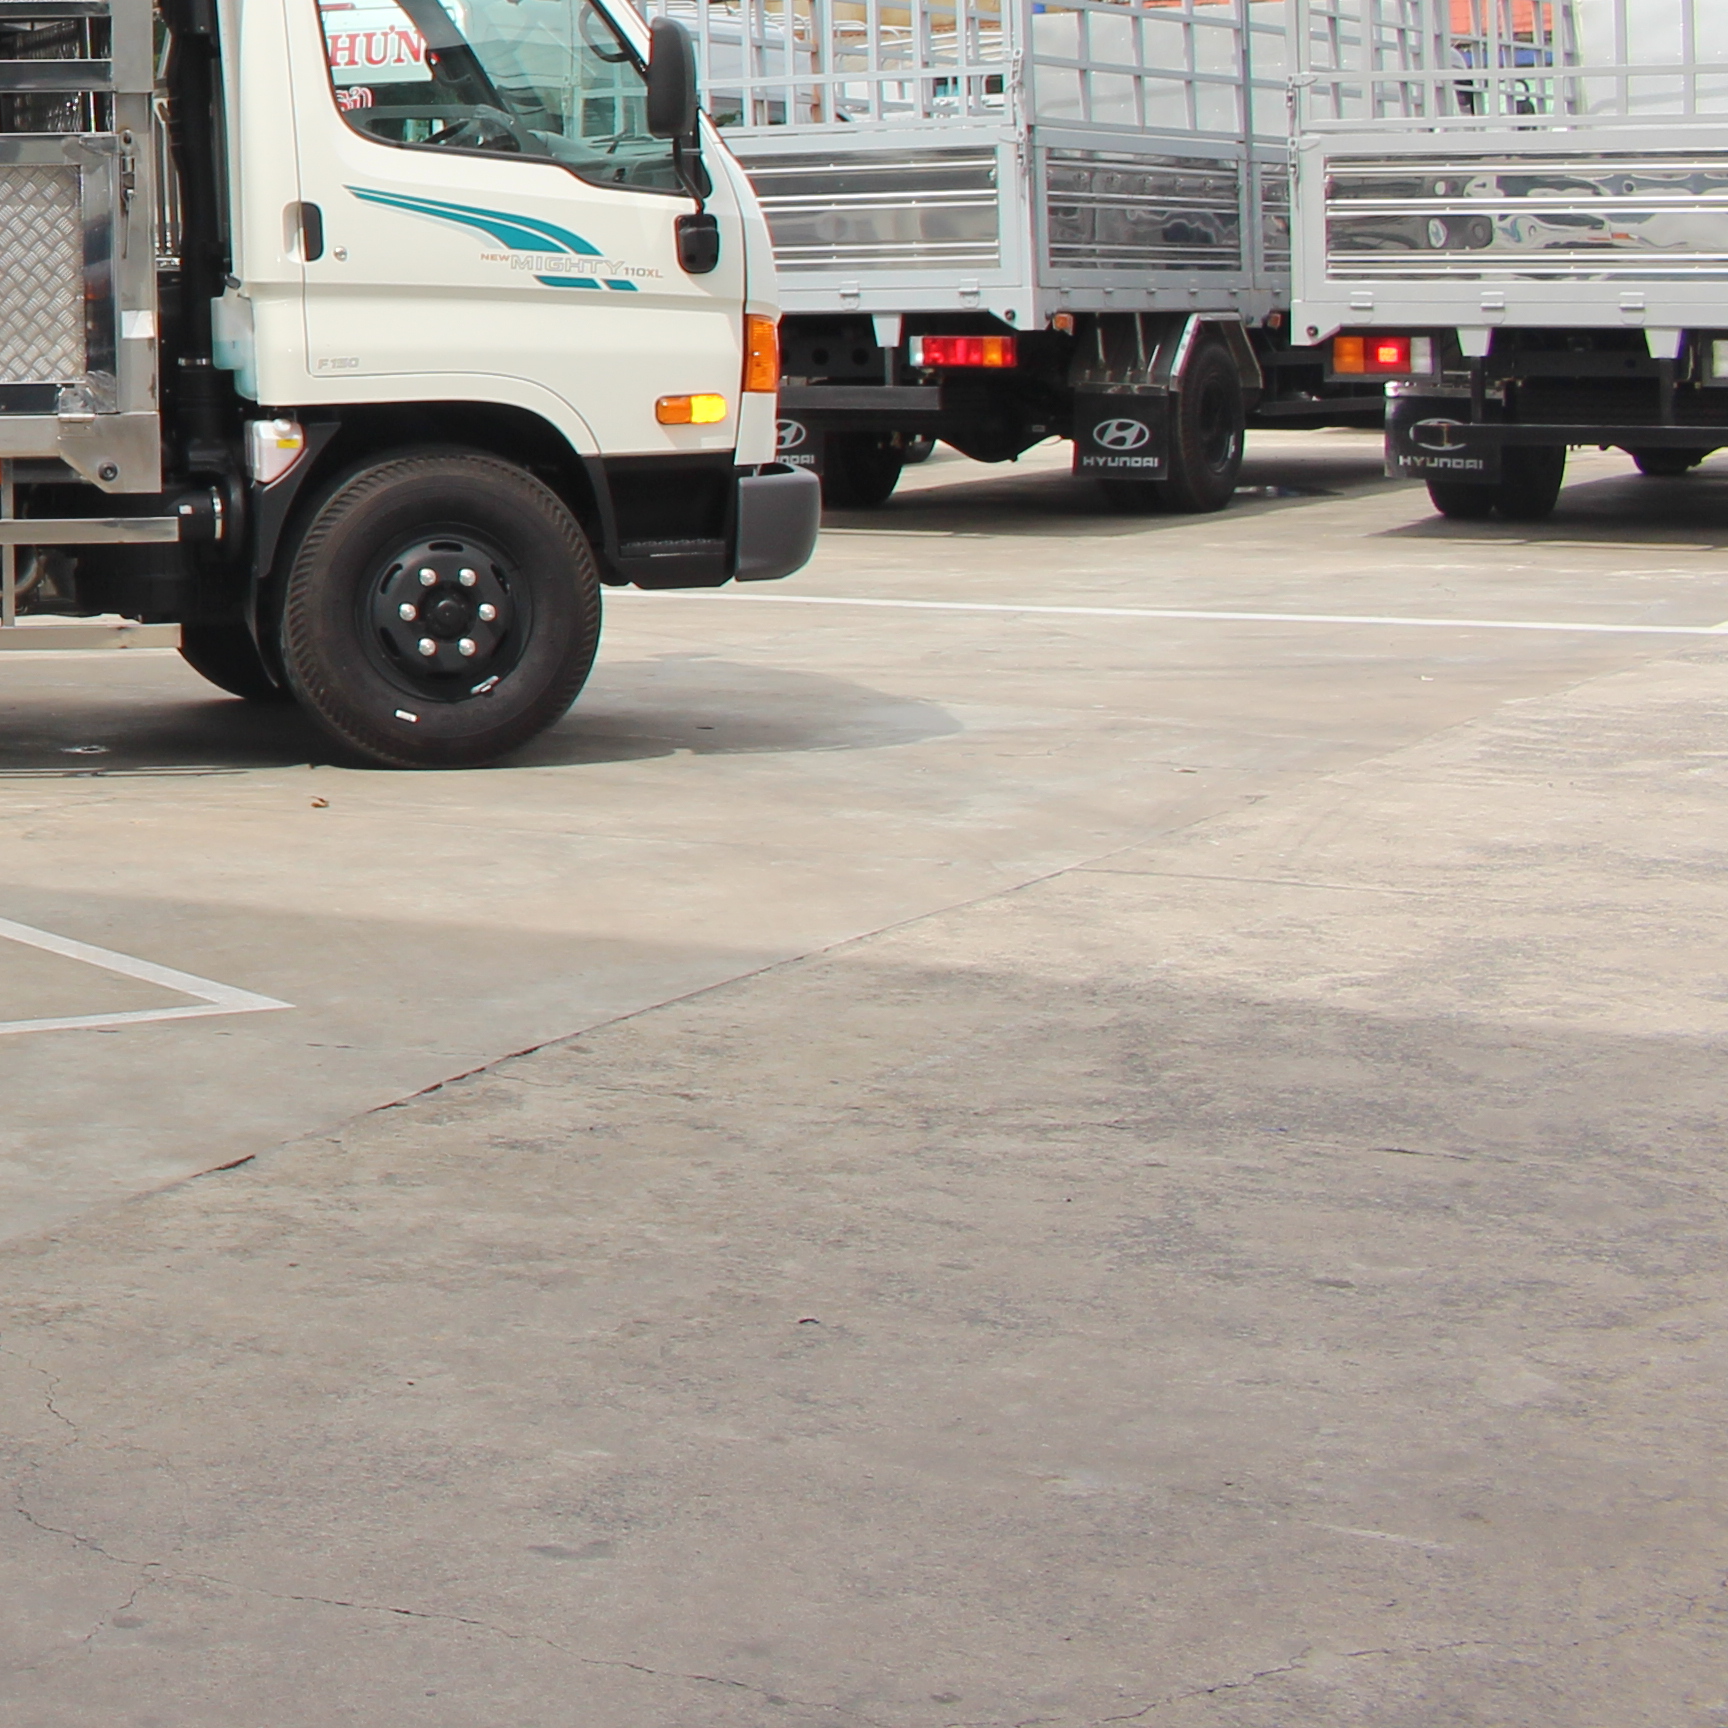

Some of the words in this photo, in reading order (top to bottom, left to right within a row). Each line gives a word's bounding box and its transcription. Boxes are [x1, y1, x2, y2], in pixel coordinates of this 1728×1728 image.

[328, 24, 441, 66] HƯN
[480, 253, 511, 262] NEW
[510, 254, 626, 275] MIGHTY
[623, 266, 664, 279] 110XL
[775, 454, 815, 465] NDAI
[1082, 455, 1160, 468] HYUNDAI
[1398, 454, 1484, 470] HYUNDAI
